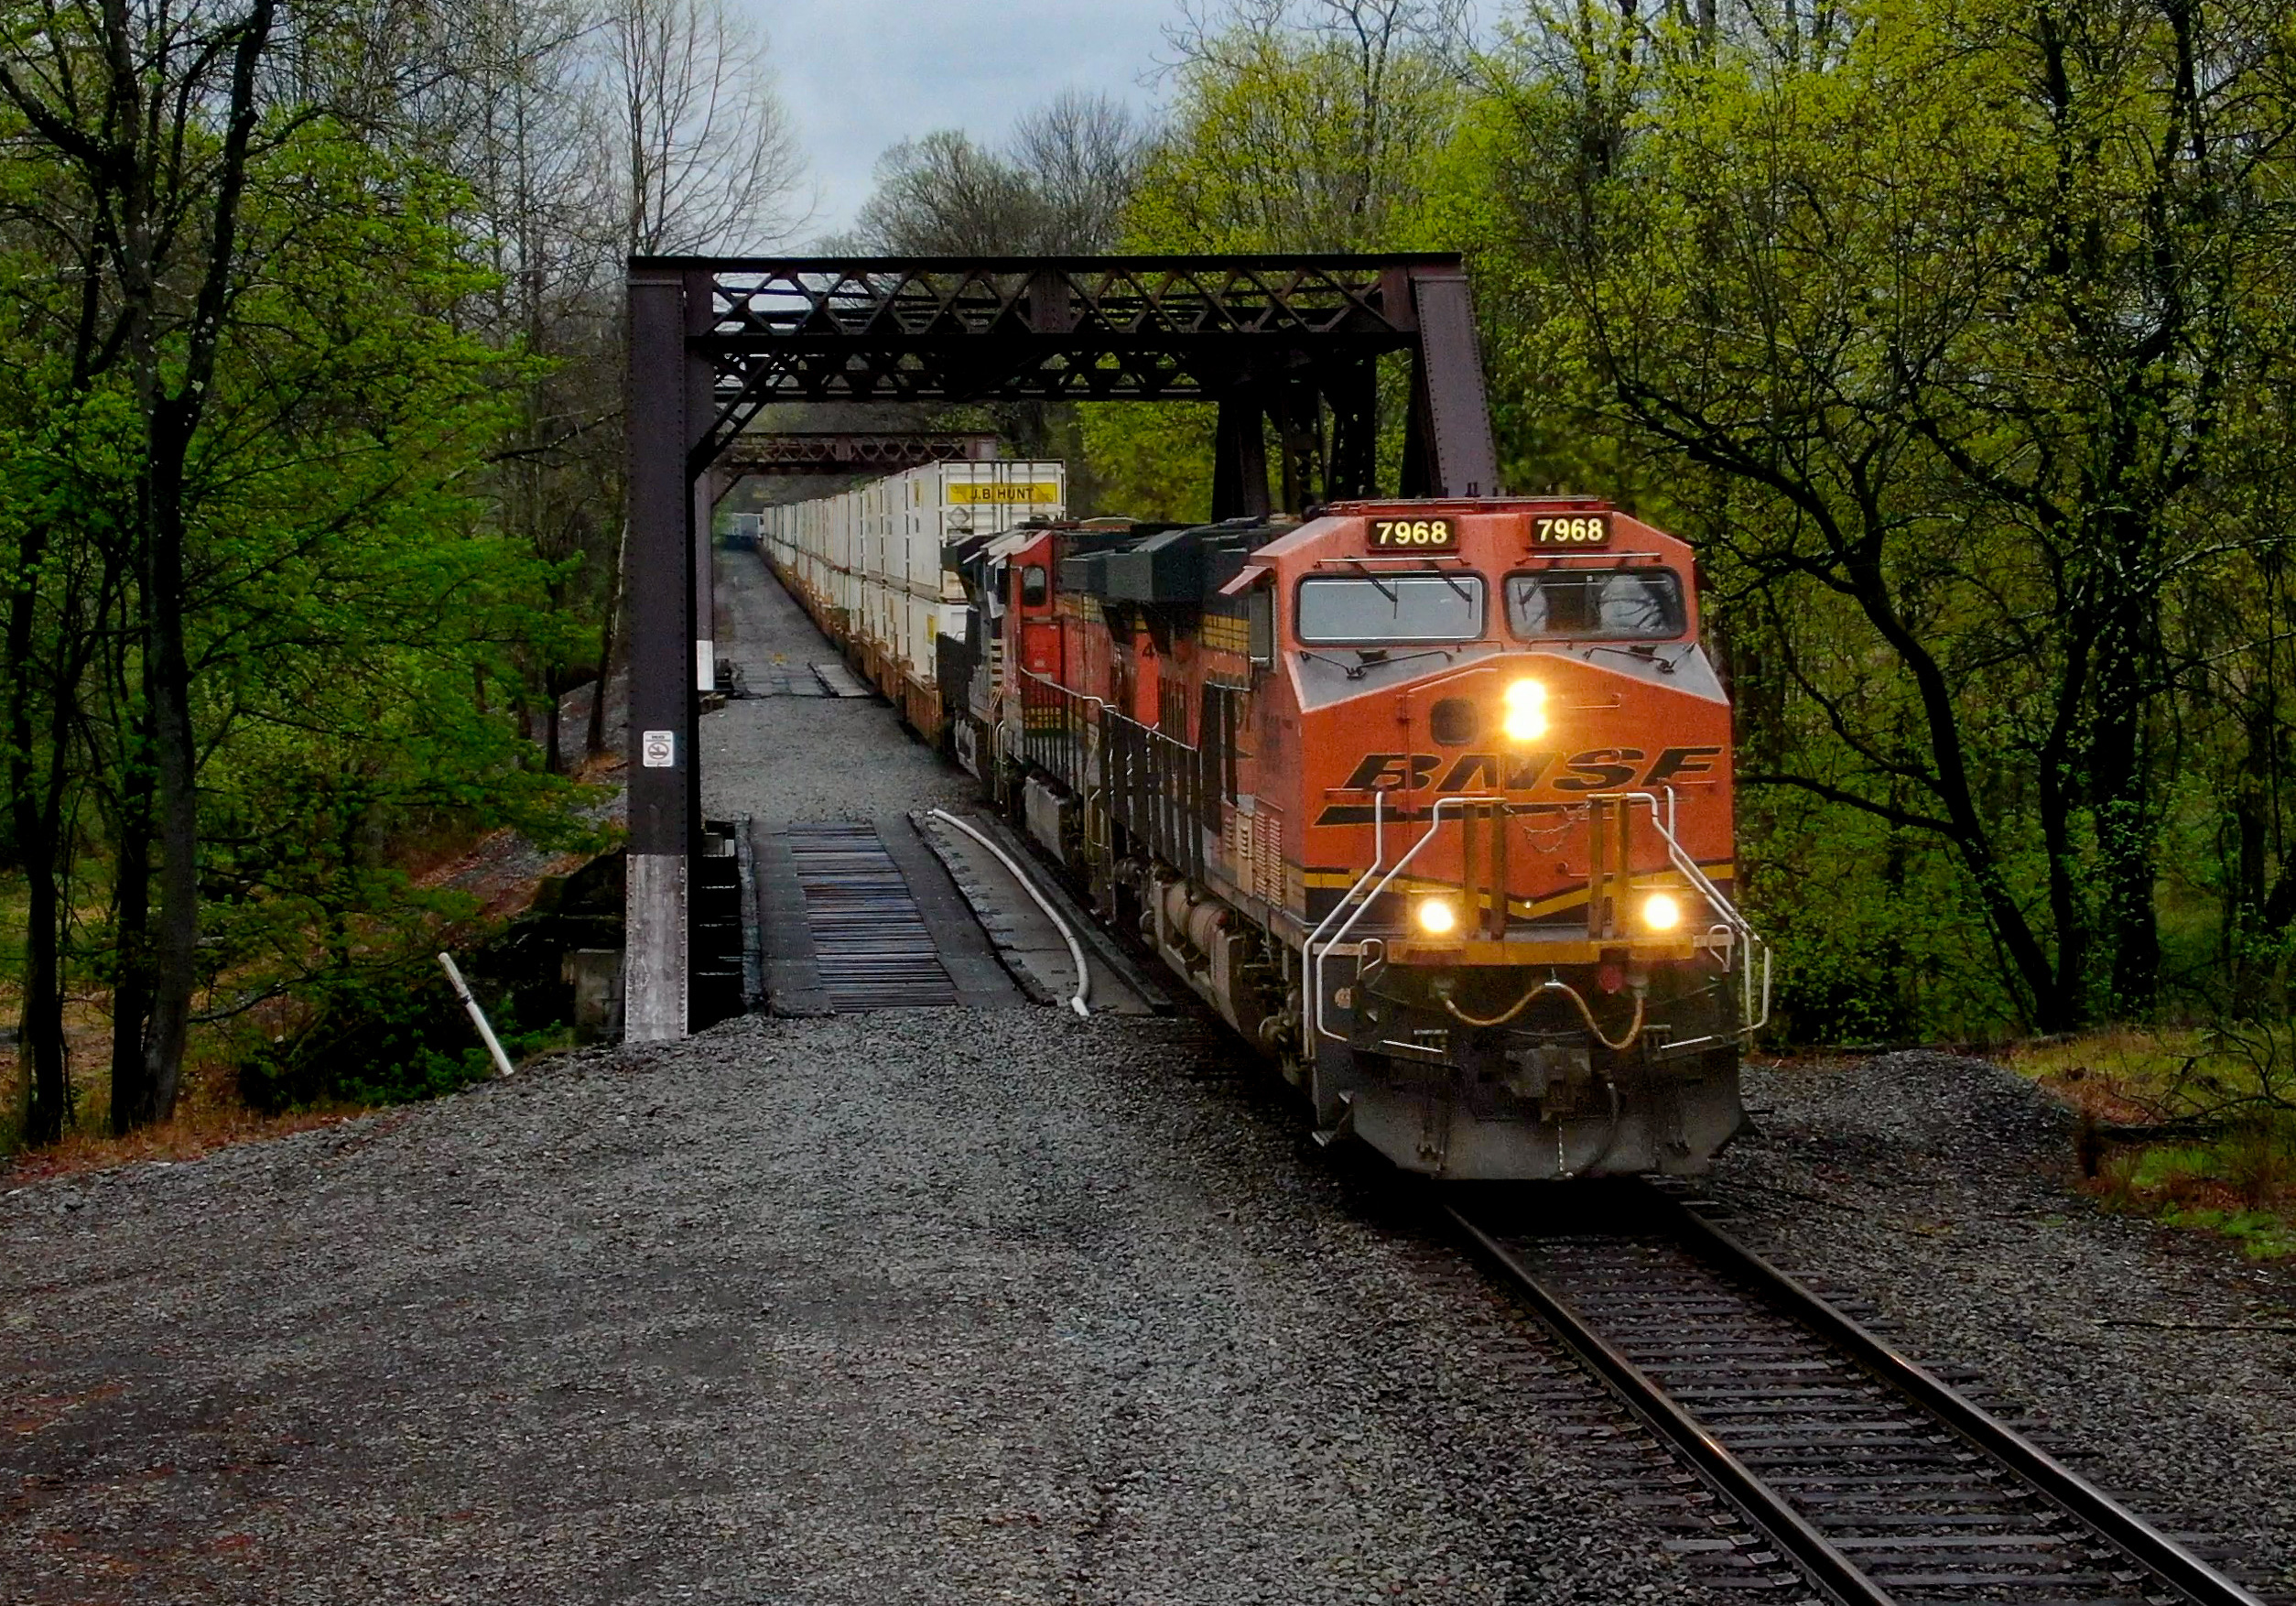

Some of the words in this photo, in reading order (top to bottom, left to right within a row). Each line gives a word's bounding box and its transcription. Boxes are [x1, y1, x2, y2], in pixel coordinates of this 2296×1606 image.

[997, 486, 1034, 500] HUNT
[1376, 520, 1448, 545] 7968
[1537, 517, 1604, 542] 7968
[1340, 745, 1723, 793] BNSF
